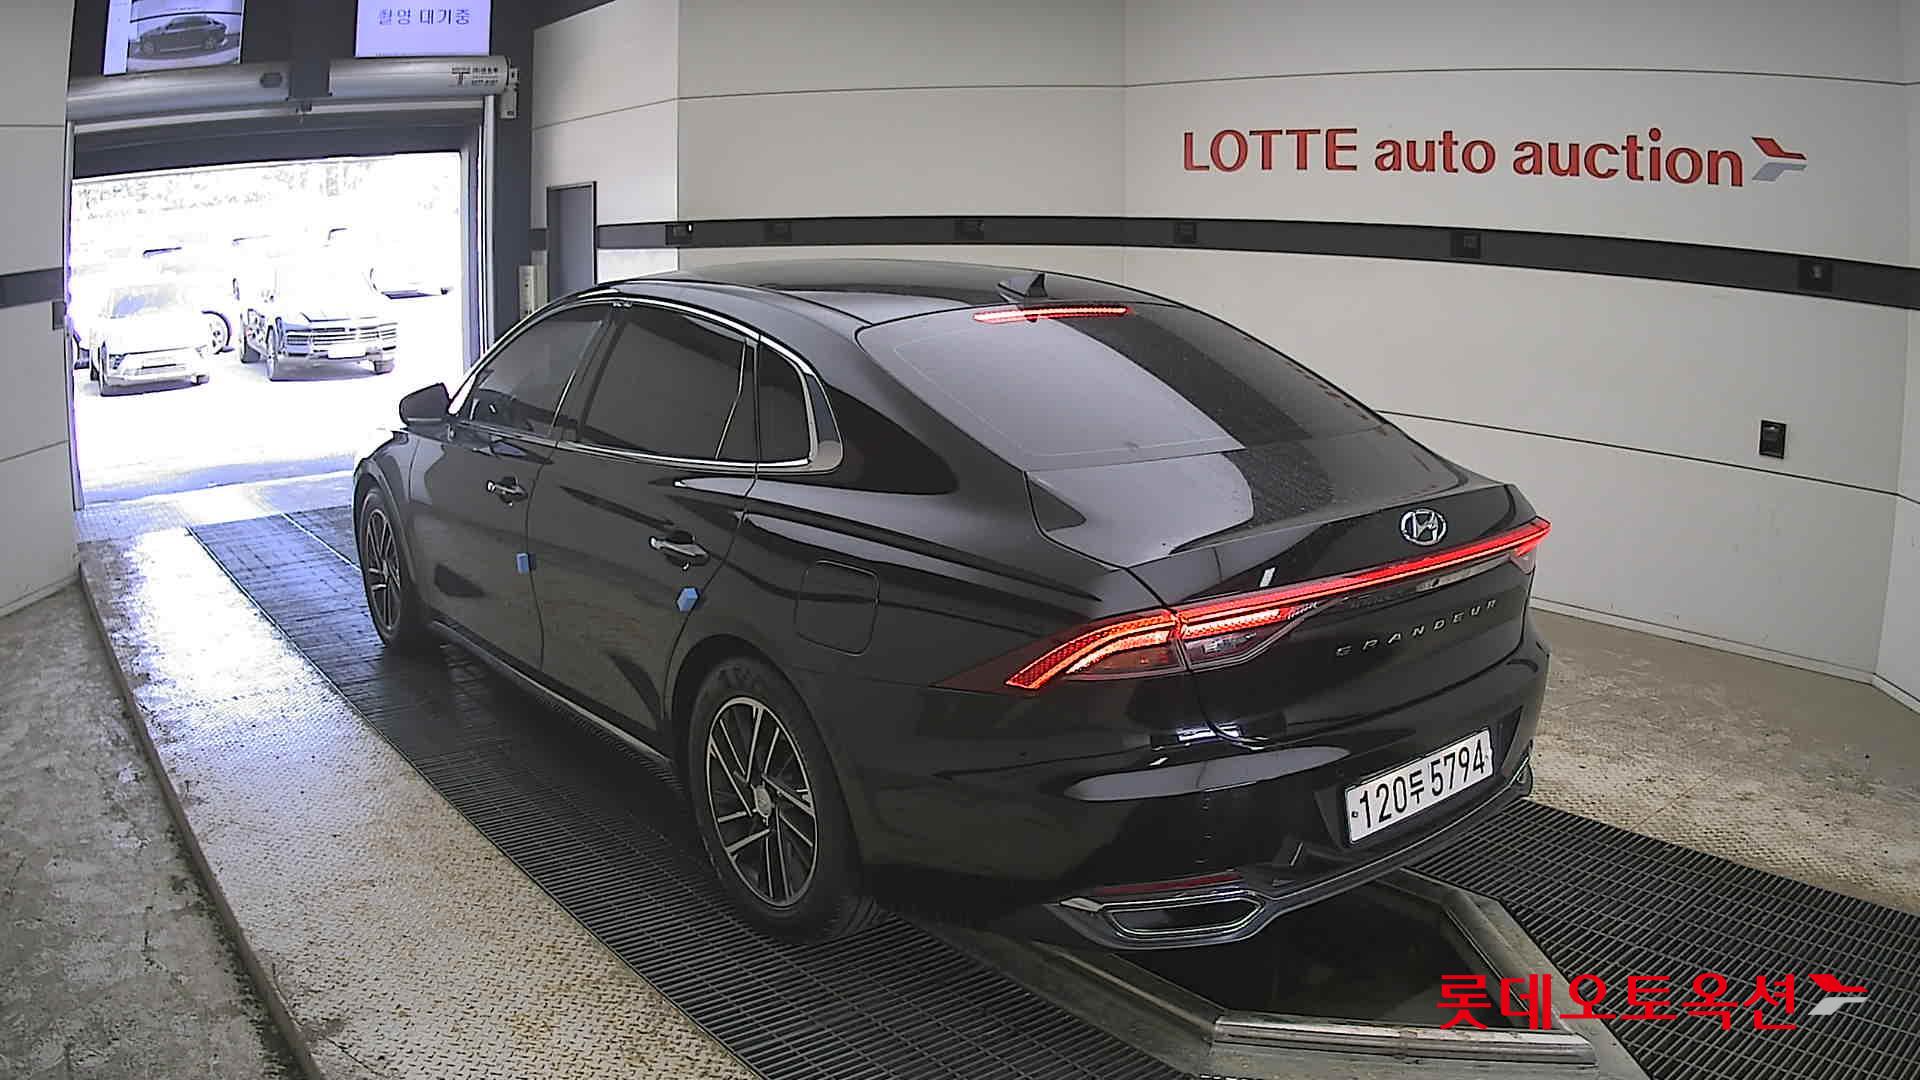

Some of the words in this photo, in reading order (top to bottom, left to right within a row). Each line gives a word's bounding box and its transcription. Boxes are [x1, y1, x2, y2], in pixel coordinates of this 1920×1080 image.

[419, 8, 470, 25] 대기중
[1183, 128, 1358, 173] LOTTE
[1374, 130, 1497, 174] auto
[1512, 127, 1744, 188] auction
[1335, 599, 1497, 656] GRANDEUR
